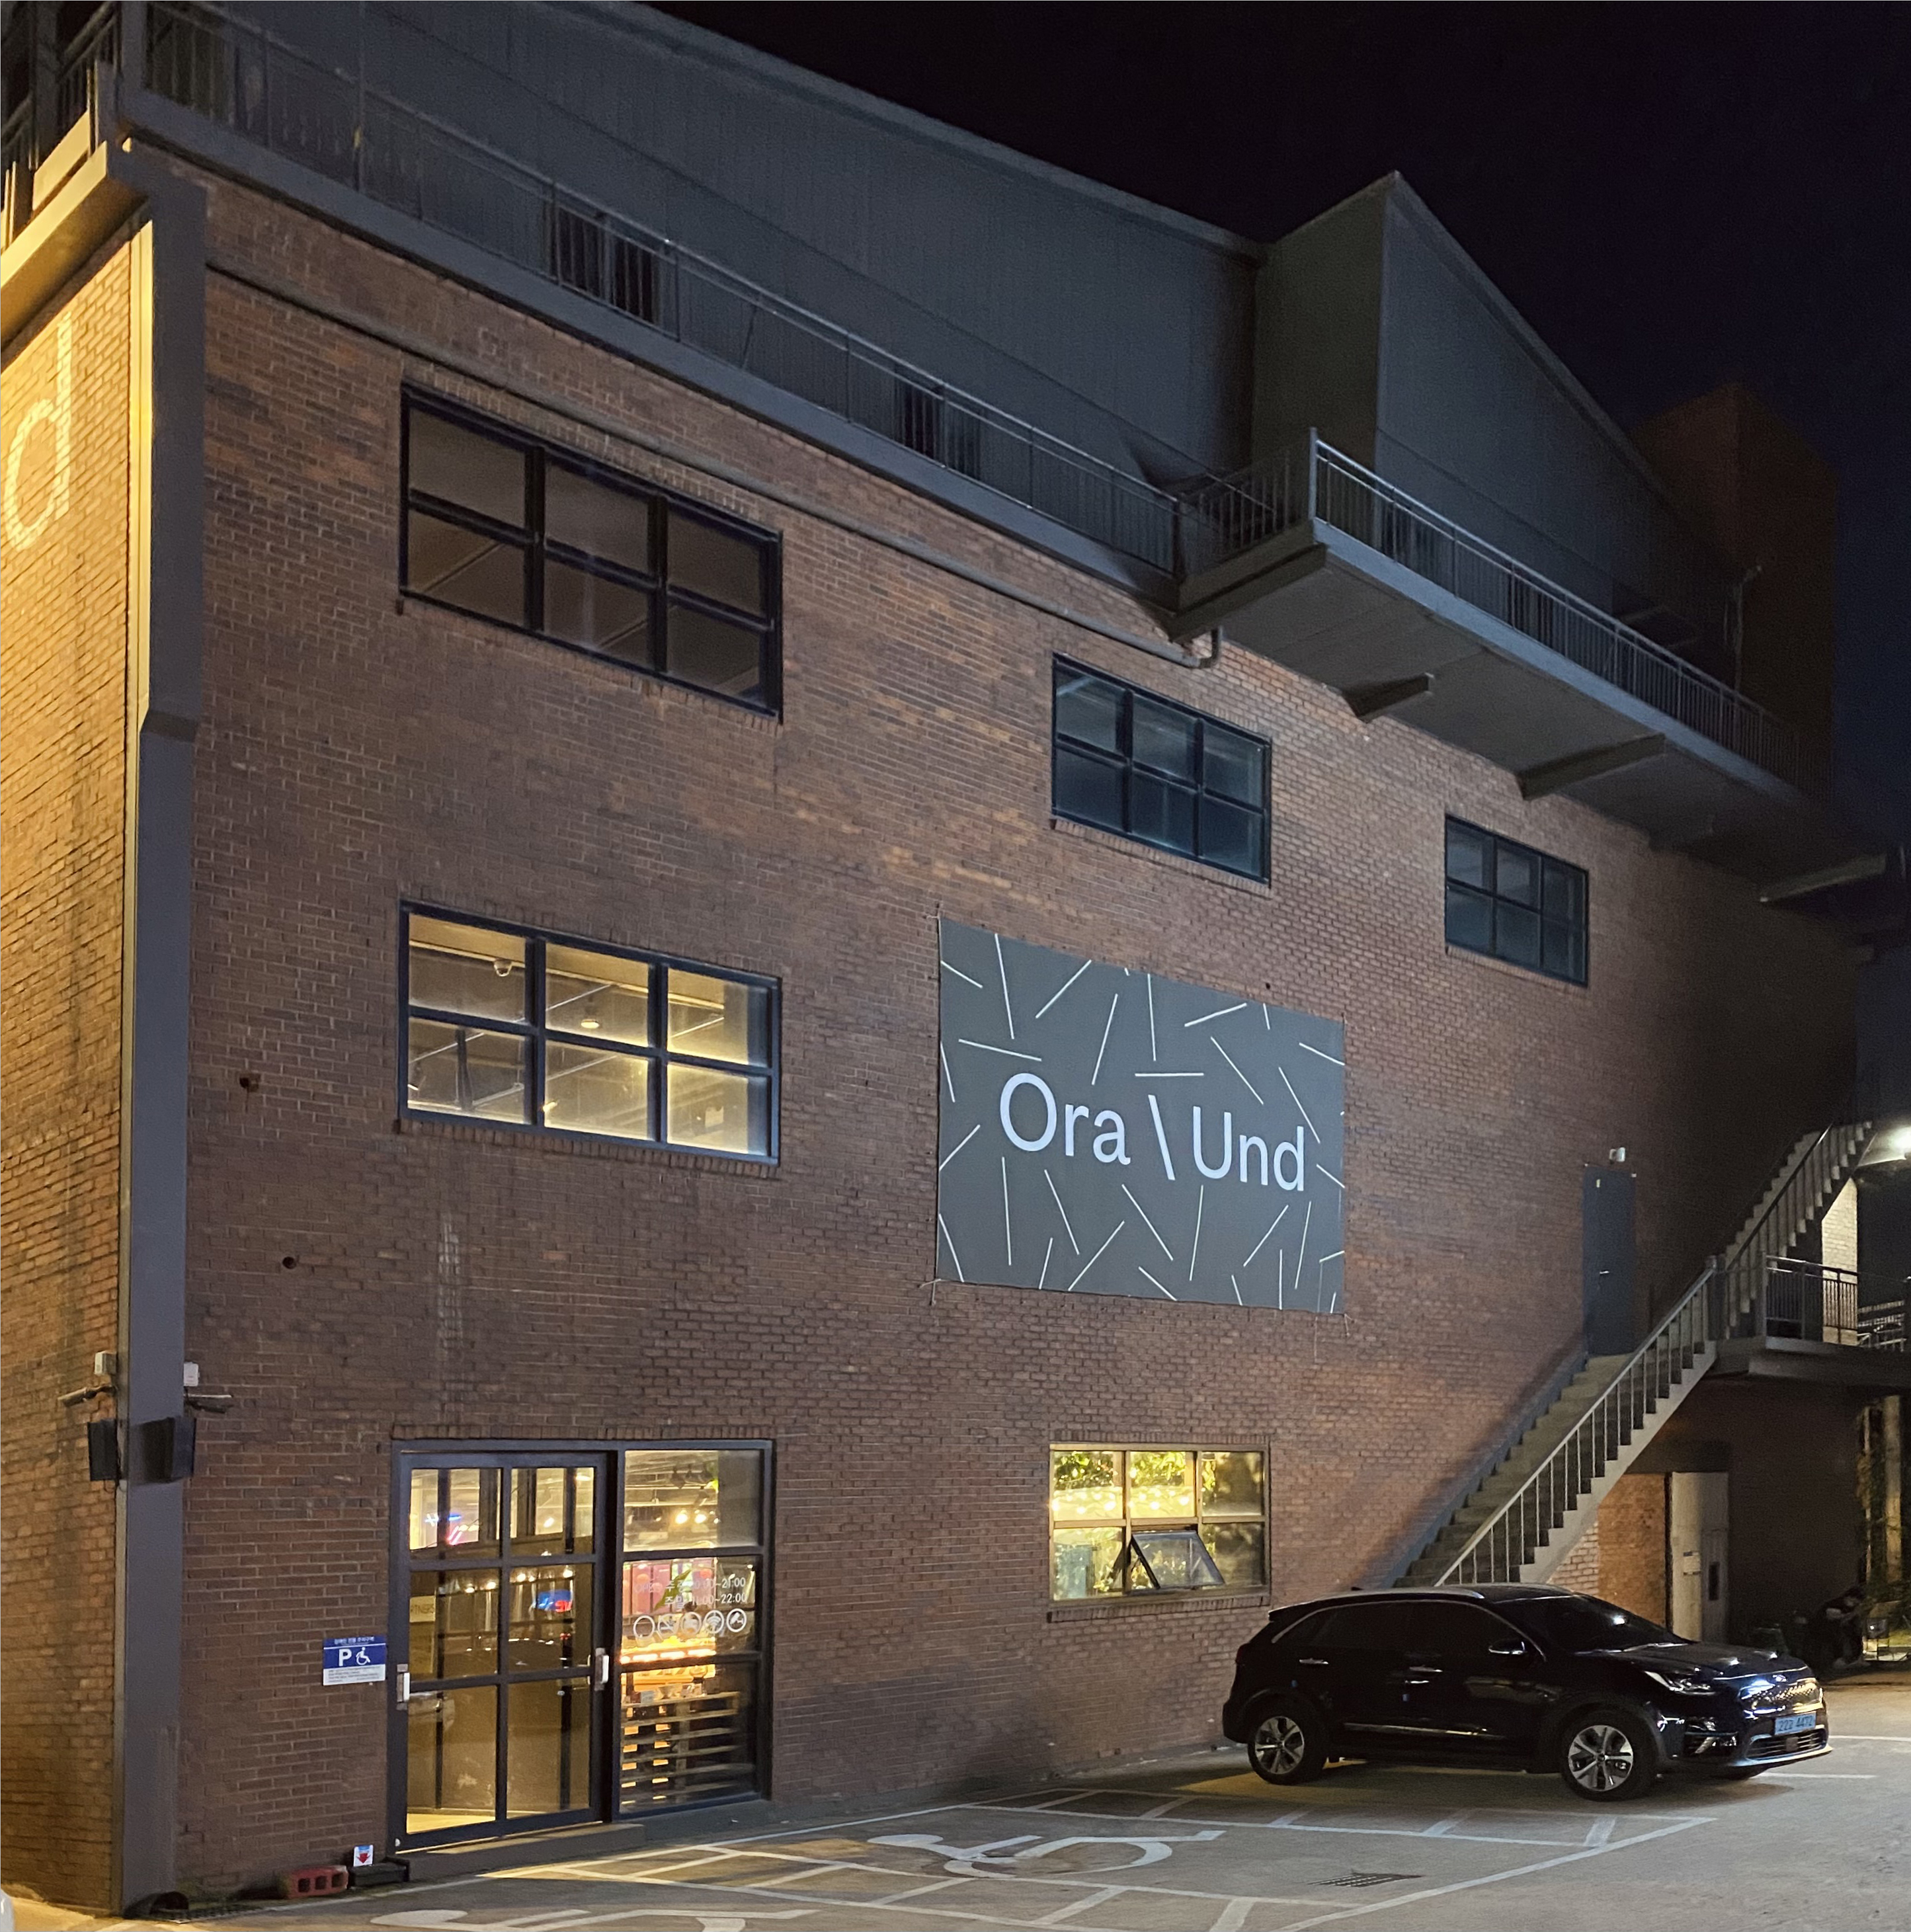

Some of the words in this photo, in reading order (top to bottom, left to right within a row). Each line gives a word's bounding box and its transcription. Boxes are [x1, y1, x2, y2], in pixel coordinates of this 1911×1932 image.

[999, 1072, 1131, 1166] Ora
[1192, 1106, 1305, 1191] Und
[339, 1648, 352, 1666] P
